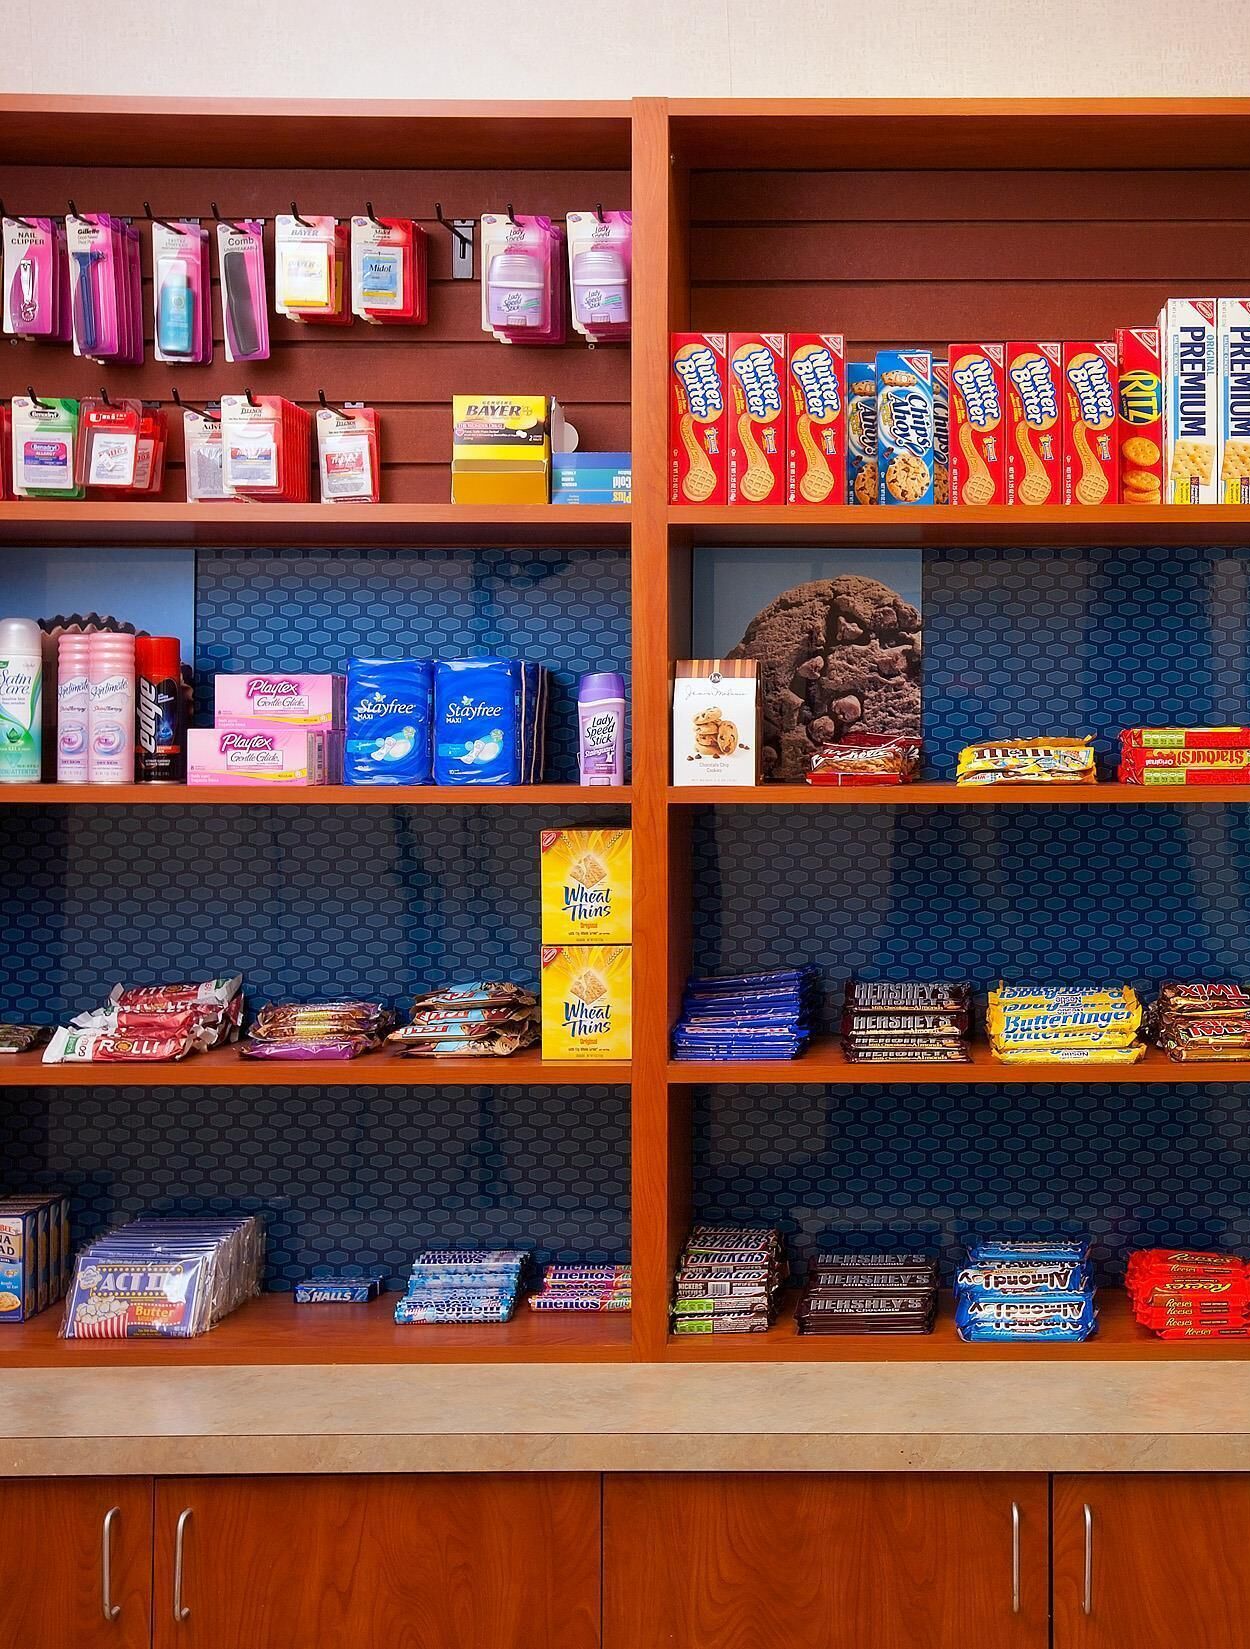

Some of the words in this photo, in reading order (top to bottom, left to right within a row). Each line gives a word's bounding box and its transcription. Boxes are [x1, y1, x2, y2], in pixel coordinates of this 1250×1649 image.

[77, 228, 100, 236] Gillette
[11, 238, 45, 246] CLIPPER
[227, 237, 255, 247] Comb
[369, 264, 391, 273] Midol
[677, 361, 707, 416] Butter
[692, 350, 720, 410] Nutter
[735, 361, 766, 416] Butter
[750, 350, 779, 410] Nutter
[809, 350, 839, 410] Nutter
[1030, 359, 1057, 417] Nutter
[1088, 359, 1114, 416] Nutter
[1180, 327, 1206, 436] PREMIUM
[793, 362, 825, 417] Butter
[954, 370, 985, 424] Butter
[973, 360, 1000, 418] Nutter
[1012, 368, 1042, 423] Butter
[1069, 369, 1099, 424] Butter
[1119, 373, 1159, 422] RITZ
[466, 405, 521, 417] BAYER
[908, 395, 932, 448] Chips
[613, 476, 631, 488] Cold
[613, 492, 631, 504] Plus
[0, 669, 31, 685] Satin
[91, 678, 127, 697] Skintimate
[248, 679, 298, 697] Playtex
[257, 697, 281, 707] Gentle
[281, 697, 305, 707] Glide
[357, 698, 415, 717] Stayfree
[137, 680, 163, 754] edge
[446, 702, 502, 720] Stayfree
[592, 714, 613, 728] Lady
[585, 724, 614, 739] Speed
[590, 733, 612, 747] Stick
[221, 733, 273, 752] Playtex
[230, 751, 256, 762] Gentle
[255, 751, 280, 762] Glide
[1145, 758, 1174, 766] Original
[1177, 749, 1244, 763] Starburst
[563, 884, 611, 905] Wheat
[561, 902, 611, 921] Thins
[855, 982, 950, 999] HERSHEY'S
[1178, 983, 1249, 1000] Twix
[563, 1000, 611, 1021] Wheat
[561, 1018, 611, 1038] Thins
[853, 1015, 951, 1029] HERSHEY'S
[1005, 1012, 1132, 1034] Butterfinger
[689, 1253, 765, 1263] SNICKERS
[818, 1254, 926, 1263] HERSHEY'S
[100, 1272, 144, 1291] ACT
[145, 1272, 166, 1291] II
[551, 1271, 614, 1280] mentos
[820, 1275, 930, 1284] HERSHEY'S
[993, 1269, 1070, 1288] Almond
[311, 1291, 351, 1302] HALLS
[536, 1298, 600, 1309] mentos
[810, 1300, 922, 1310] HERSHEY'S
[135, 1306, 175, 1319] Butter
[436, 1304, 500, 1316] mentos
[1006, 1302, 1085, 1319] Almond
